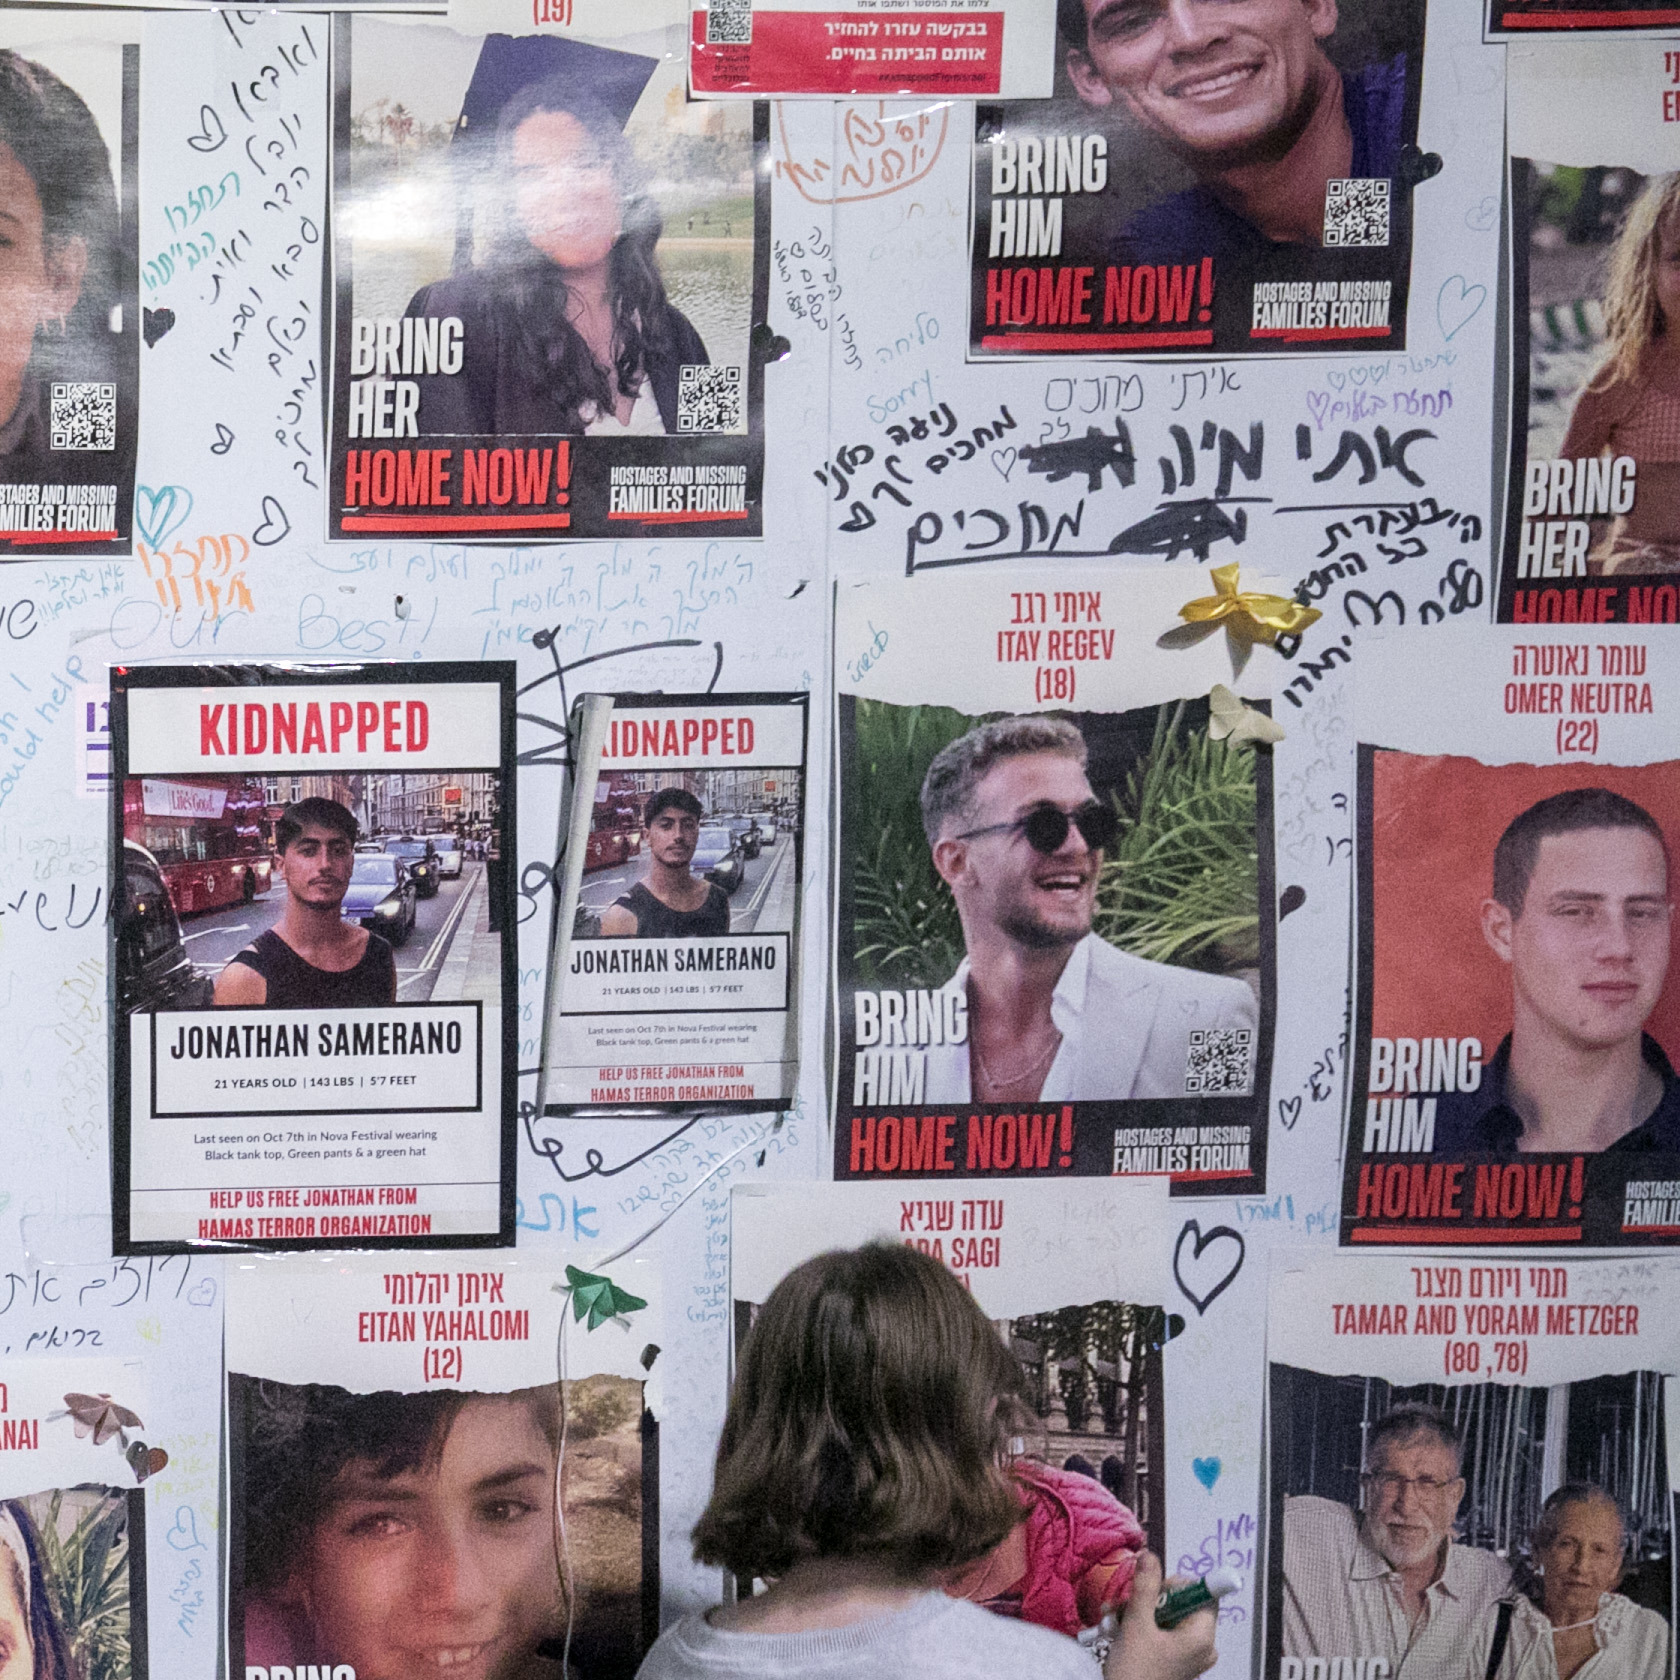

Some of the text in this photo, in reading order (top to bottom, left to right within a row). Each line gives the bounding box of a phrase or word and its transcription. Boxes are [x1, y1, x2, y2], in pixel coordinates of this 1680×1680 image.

[823, 19, 988, 39] בבקשה עזרו להחזיר
[825, 46, 987, 62] אותם הביתה בחיים.
[996, 628, 1116, 662] ITAY REGEV
[1034, 666, 1076, 703] (18)
[1503, 682, 1653, 715] OMER NEUTRA
[200, 700, 429, 756] KIDNAPPED
[1555, 719, 1599, 755] (22)
[170, 1020, 462, 1060] JONATHAN SAMERANO
[214, 1074, 417, 1089] 21 YEARS OLD 143 LBS 5'7 FEET
[193, 1130, 437, 1144] Last seen on Oct 7th in Nova Festival wearing
[205, 1150, 234, 1160] Black
[237, 1150, 261, 1160] tank
[263, 1150, 285, 1161] top,
[288, 1149, 320, 1159] Green
[323, 1149, 352, 1161] pants
[355, 1148, 365, 1158] &
[375, 1149, 407, 1160] green
[409, 1146, 426, 1157] hat
[209, 1187, 418, 1209] HELP US FREE JONATHAN FROM
[198, 1214, 432, 1240] HAMAS TERROR ORGANIZATION
[358, 1309, 529, 1343] EITAN YAHALOMI
[1332, 1303, 1639, 1336] TAMAR AND YORAM METZGER
[423, 1346, 463, 1382] (12)
[1443, 1339, 1529, 1375] (80 ,78)
